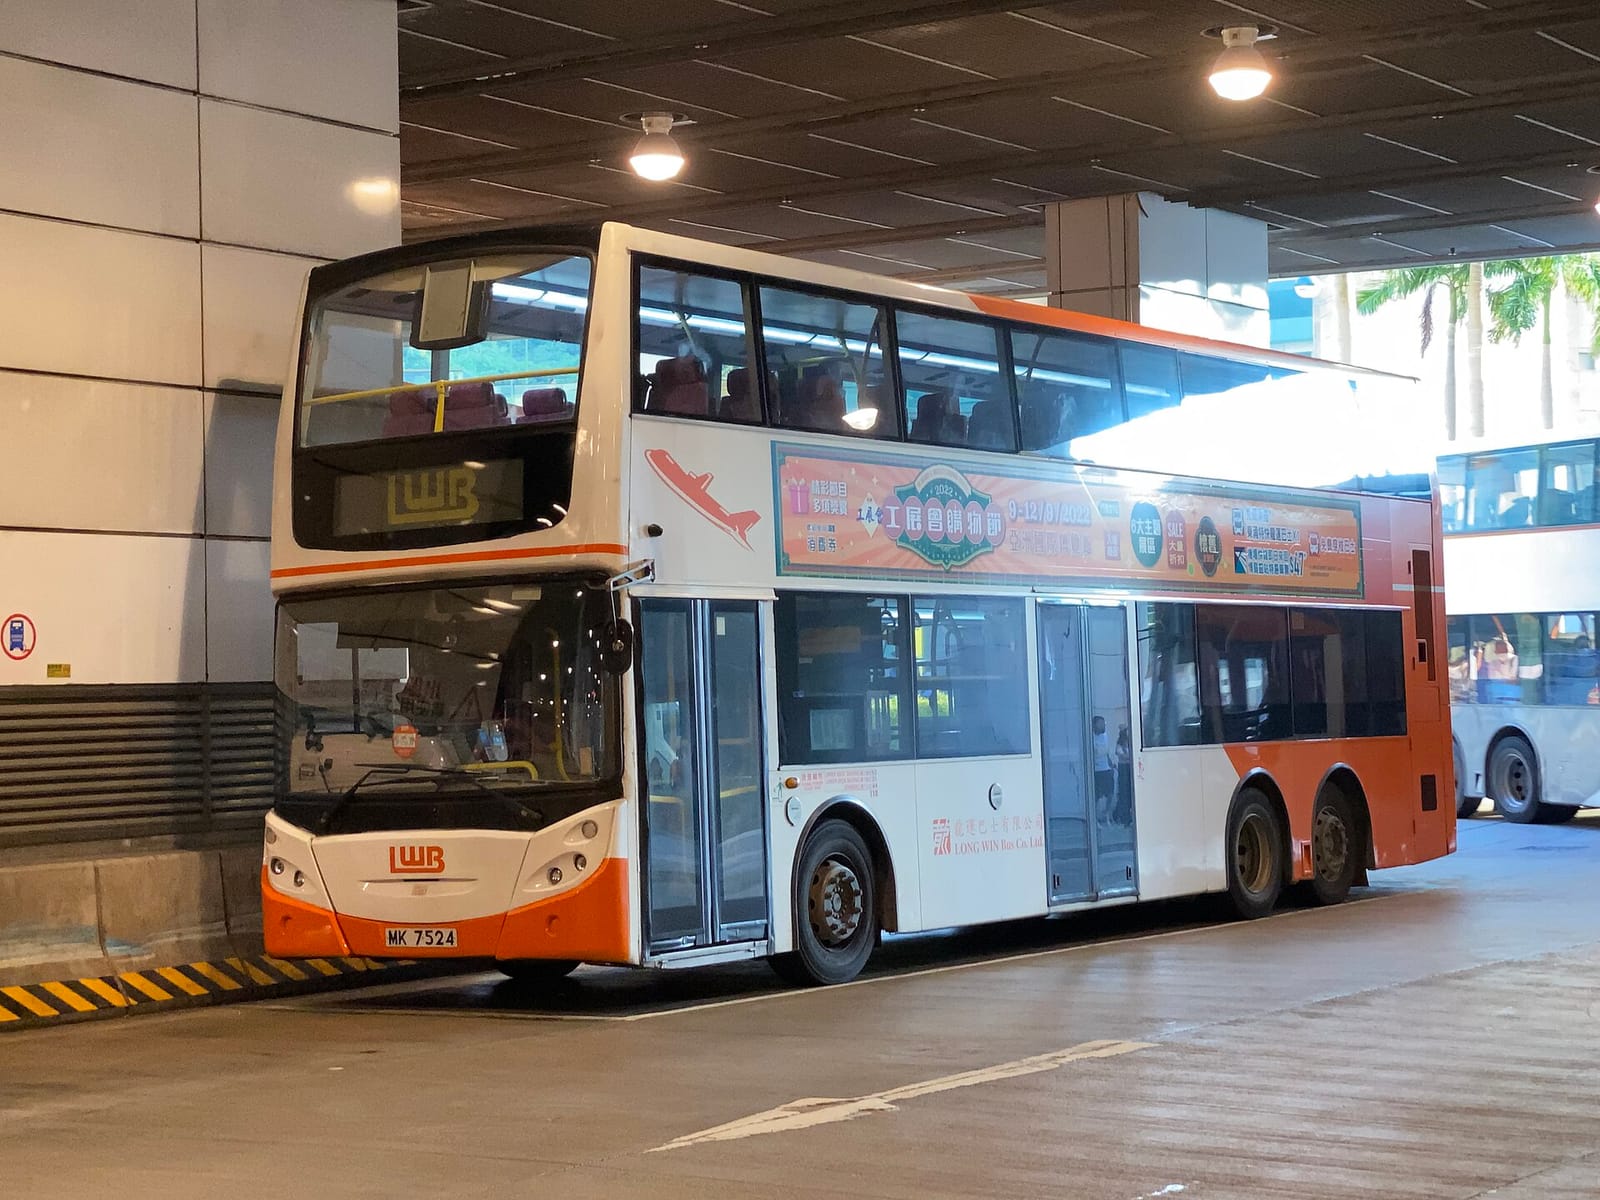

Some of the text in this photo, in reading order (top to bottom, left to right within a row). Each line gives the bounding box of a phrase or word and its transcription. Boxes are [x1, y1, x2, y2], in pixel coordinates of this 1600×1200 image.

[387, 468, 479, 525] LWB
[934, 484, 954, 497] 2022
[885, 505, 1002, 537] 工展會購物節
[1168, 522, 1184, 538] SALE
[955, 841, 979, 855] LONG
[981, 839, 999, 853] WIN
[389, 846, 445, 873] LWB
[388, 930, 454, 945] MK 7524
